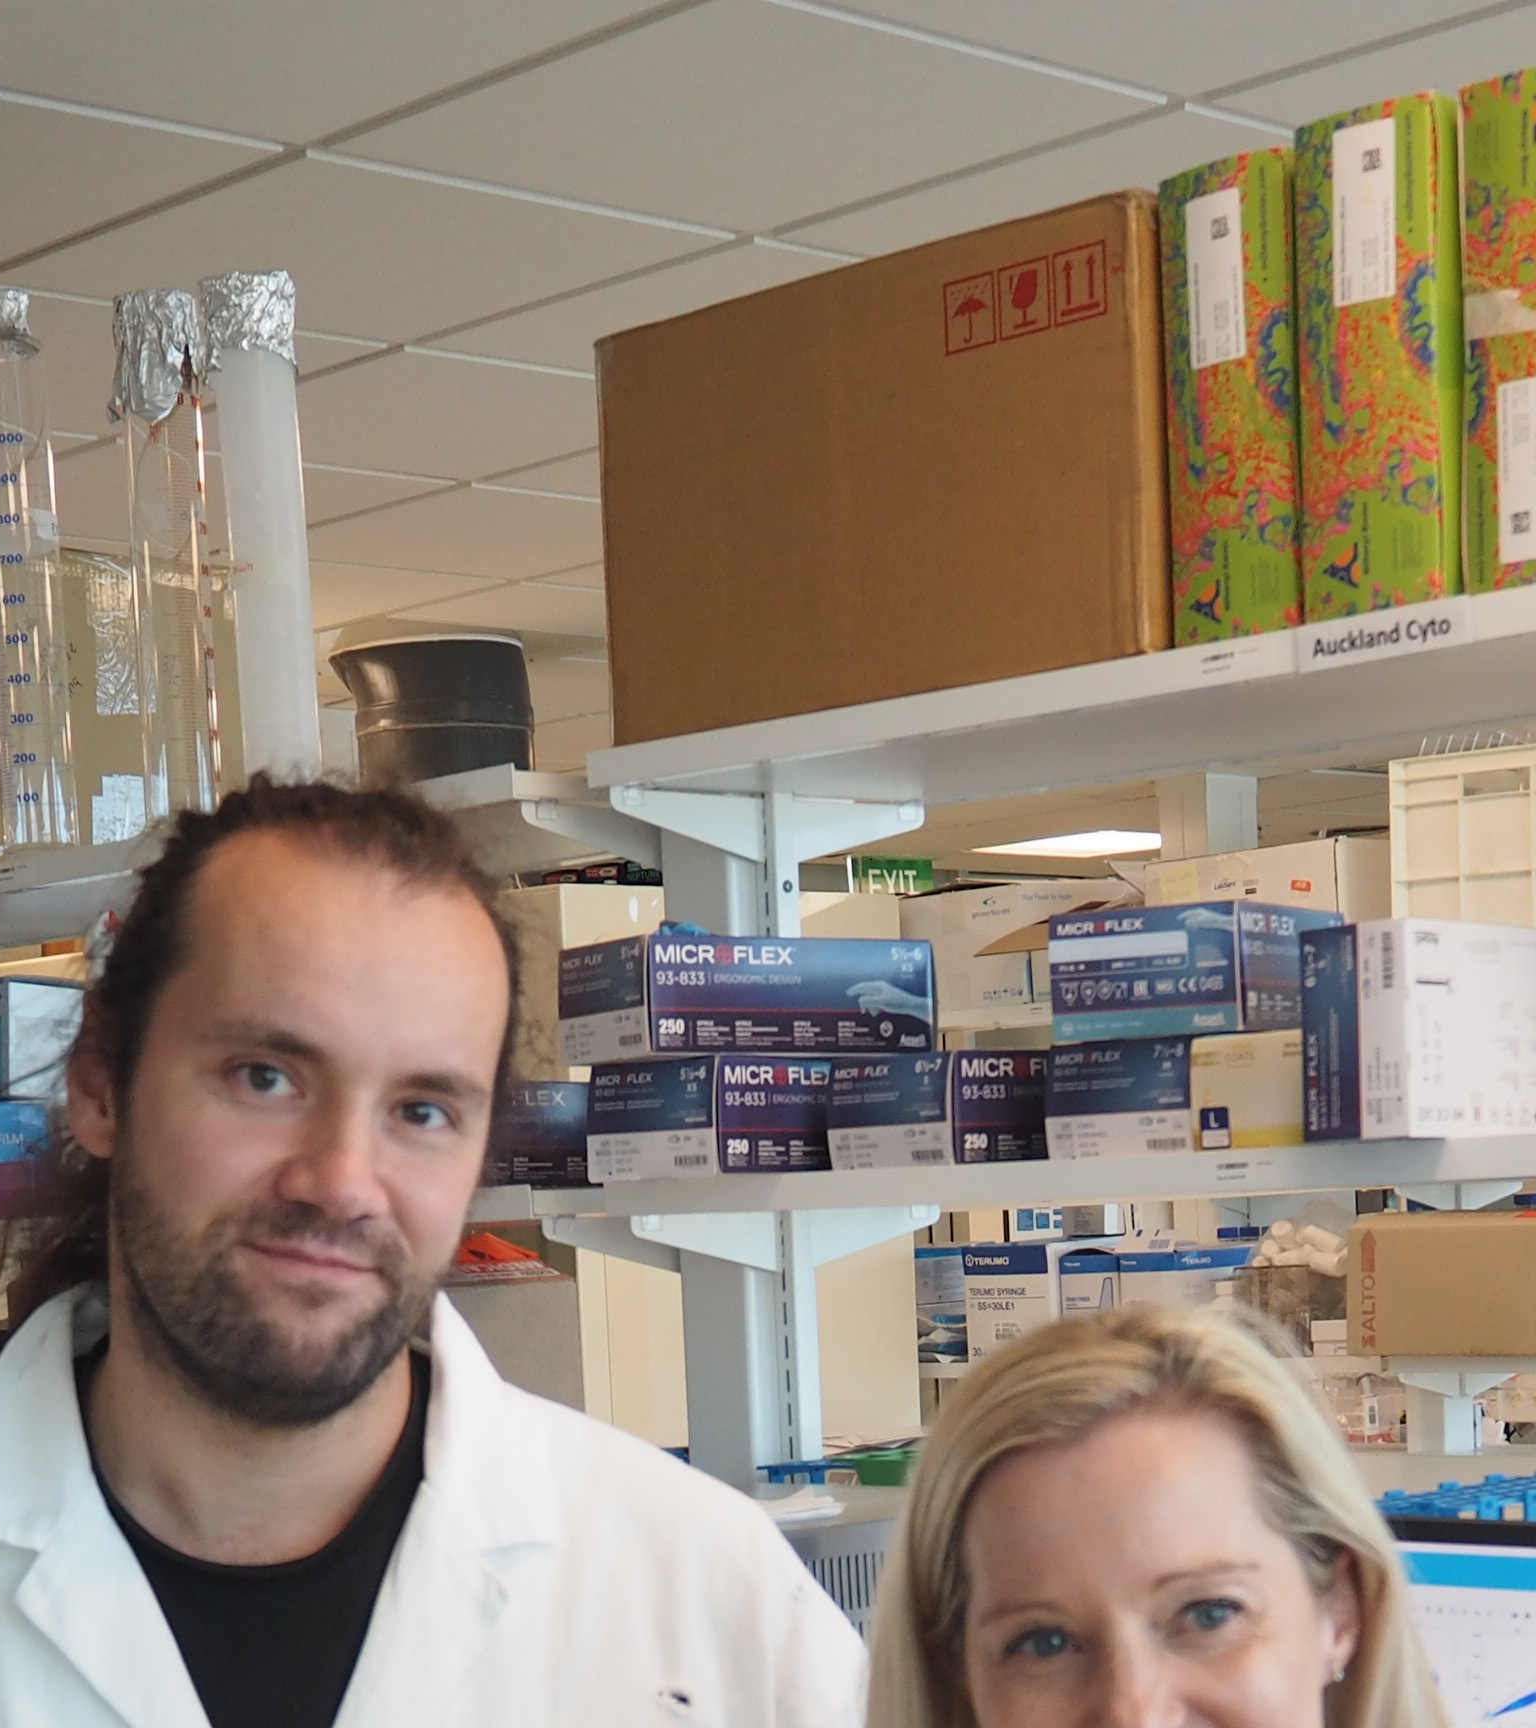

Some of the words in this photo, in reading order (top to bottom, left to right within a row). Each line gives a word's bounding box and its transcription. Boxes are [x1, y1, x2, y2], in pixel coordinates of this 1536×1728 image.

[0, 553, 23, 566] 700
[2, 593, 26, 606] 600
[6, 632, 29, 645] 500
[1312, 622, 1401, 659] Auckland
[1405, 616, 1452, 643] Cyto
[7, 672, 32, 685] 400
[10, 712, 34, 724] 300
[13, 752, 37, 764] 200
[16, 791, 39, 803] 100
[868, 868, 918, 895] EXIT
[1056, 916, 1145, 937] MICROFLEX
[654, 943, 796, 966] MICROFLEX
[655, 970, 706, 987] 93-833
[713, 974, 766, 986] ERGONOMIC
[768, 974, 802, 986] DESIGN
[658, 1018, 686, 1035] 250
[1053, 1050, 1122, 1066] MICROFLEX
[595, 1071, 654, 1087] MICROFLEX
[834, 1064, 890, 1080] MICROFLEX
[724, 1090, 766, 1107] 93-833
[961, 1084, 1007, 1100] 93-833
[1208, 1110, 1220, 1129] L
[726, 1138, 750, 1155] 250
[963, 1133, 988, 1150] 250
[973, 1256, 1010, 1266] TERUMO
[969, 1287, 996, 1297] TERUMO
[996, 1287, 1027, 1296] SYRINGE
